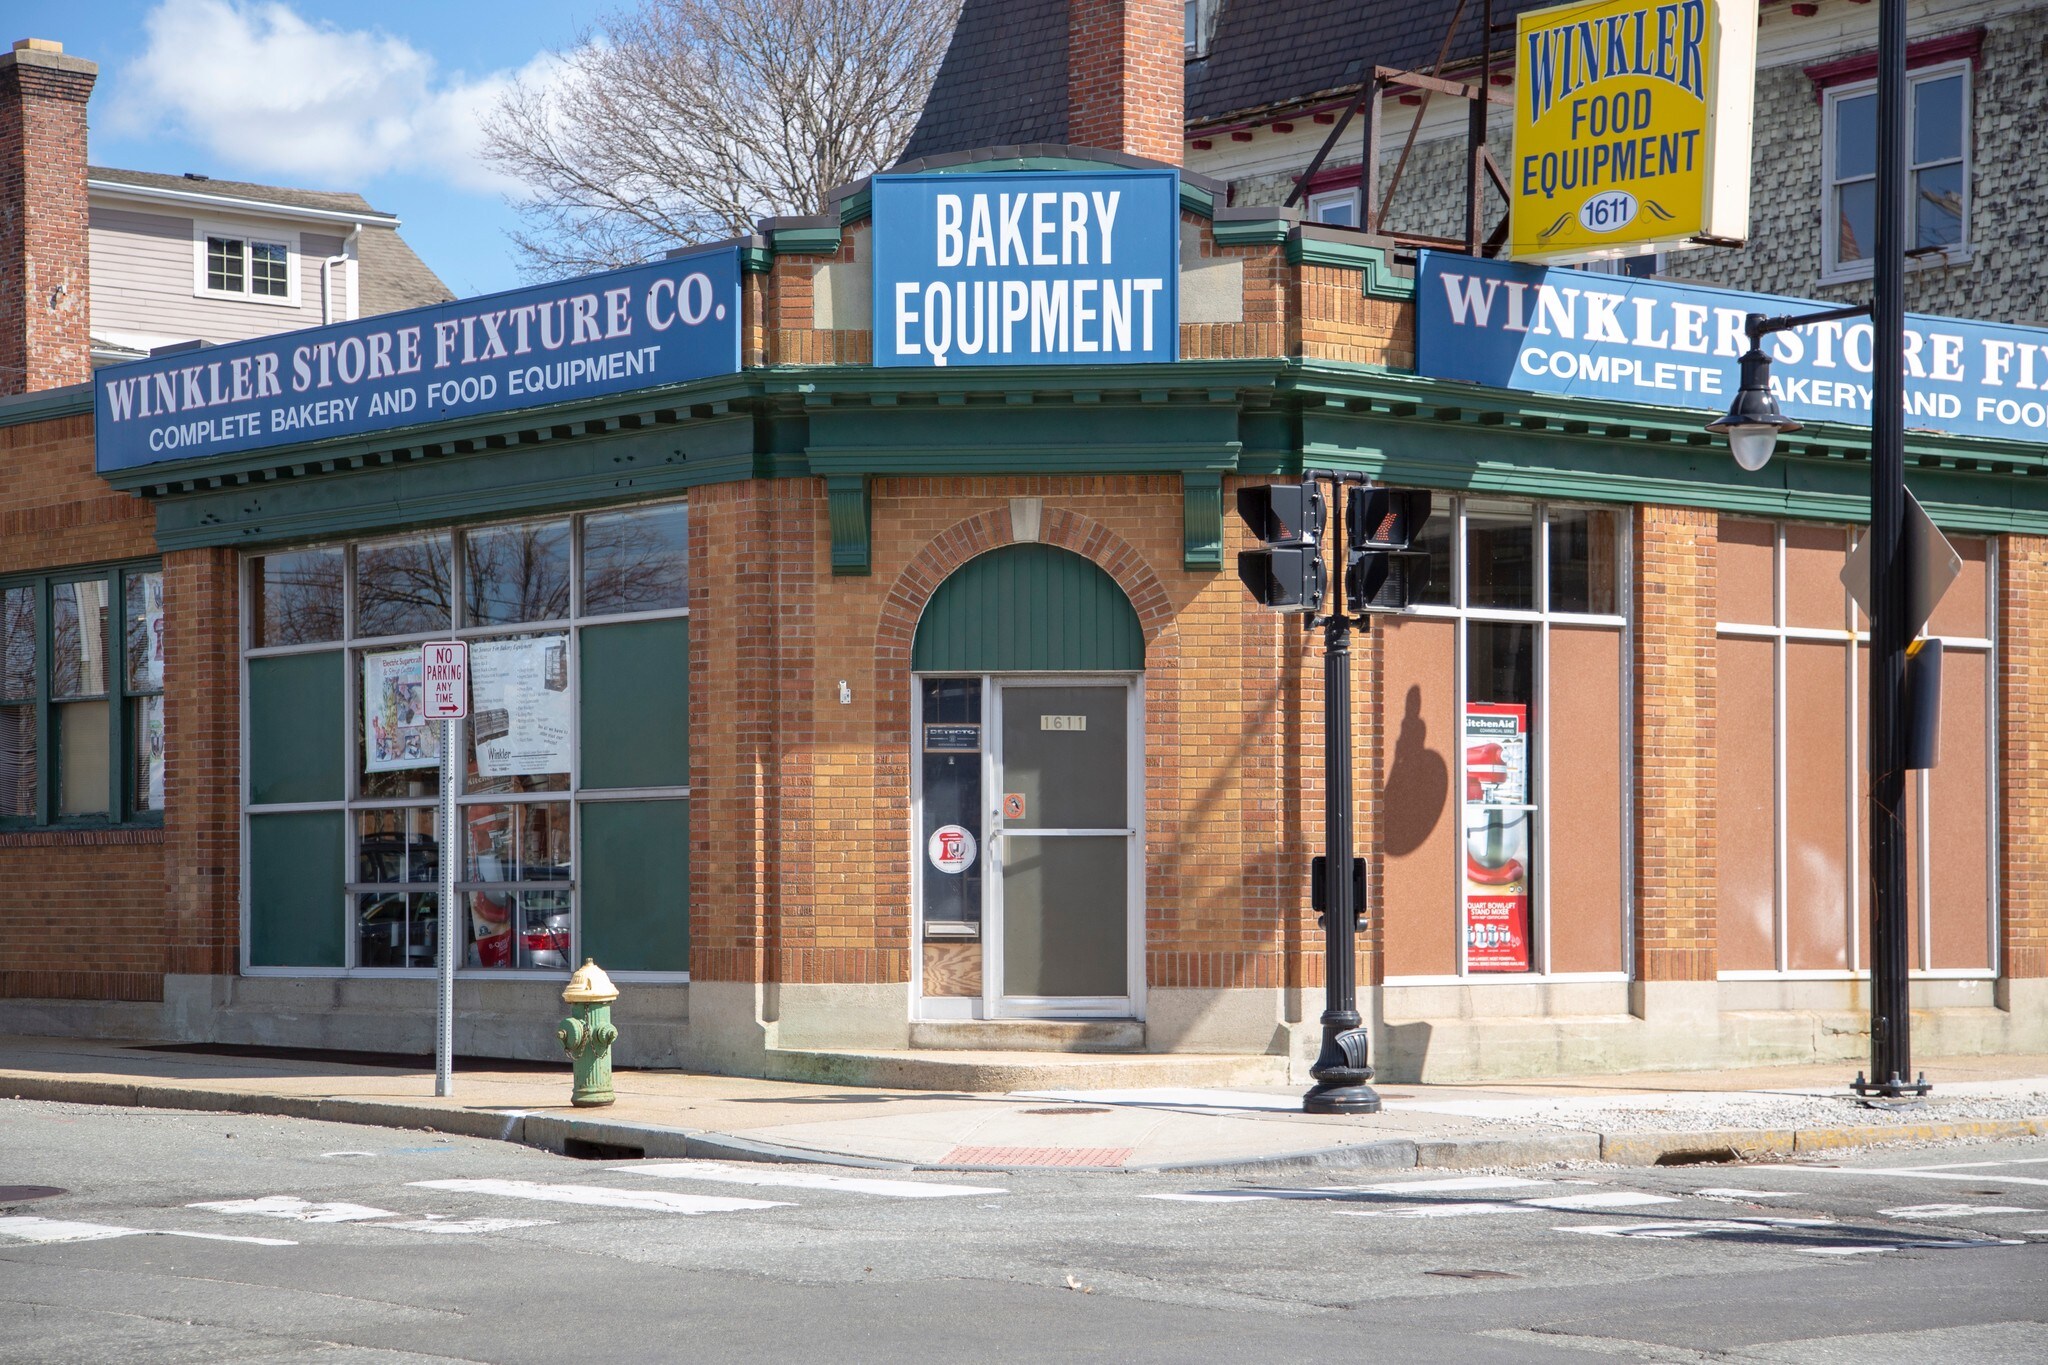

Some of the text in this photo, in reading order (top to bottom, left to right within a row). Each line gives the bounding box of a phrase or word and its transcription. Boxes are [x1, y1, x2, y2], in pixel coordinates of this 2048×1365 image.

[1528, 0, 1706, 127] WINKLER
[1571, 88, 1651, 140] FOOD
[1523, 129, 1700, 199] EQUIPMENT
[937, 191, 1121, 267] BAKERY
[1585, 196, 1629, 226] 1611
[106, 271, 727, 422] WINKLER STORE FIXTURE CO.
[895, 278, 1163, 366] EQUIPMENT
[1440, 273, 1750, 358] WINKLER
[1981, 338, 2048, 391] FI
[149, 345, 661, 453] COMPLETE BAKERY AND FOOD EQUIPMENT
[1520, 347, 2048, 428] COMPLETE AKERY ND FOO
[427, 664, 462, 681] PARKING
[436, 648, 453, 664] NO
[435, 693, 454, 703] TIME
[436, 682, 452, 692] ANY
[1044, 716, 1083, 729] 1611
[487, 748, 511, 760] Winkler
